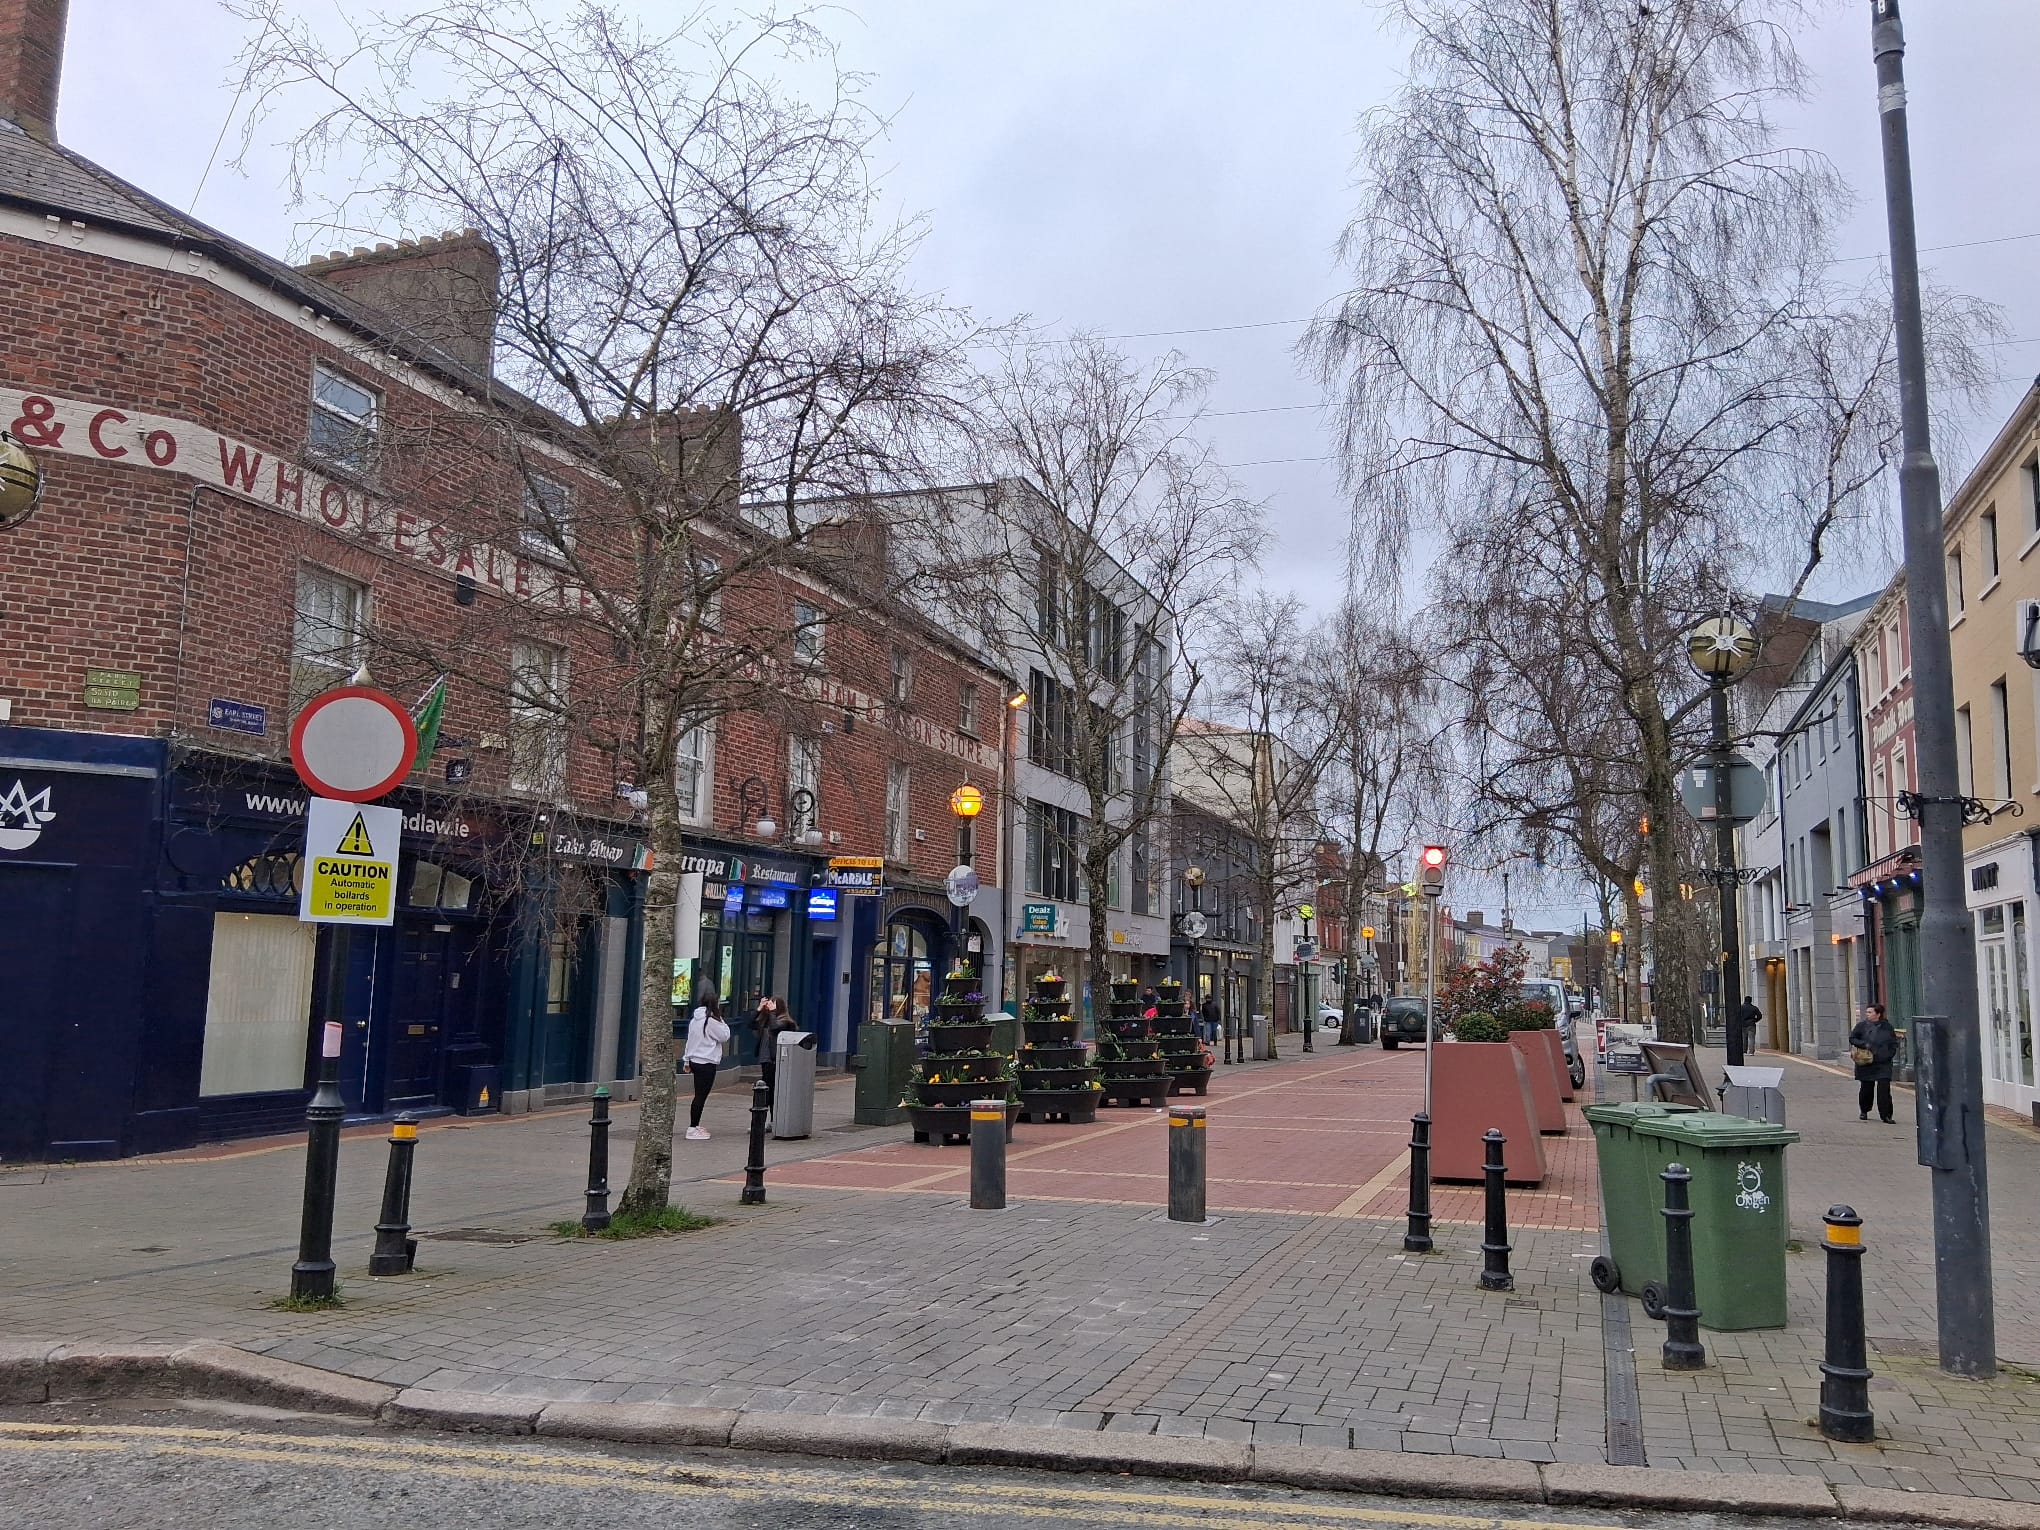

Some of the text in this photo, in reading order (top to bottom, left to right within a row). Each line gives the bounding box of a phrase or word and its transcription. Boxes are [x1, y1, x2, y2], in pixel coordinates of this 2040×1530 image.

[11, 395, 66, 449] &
[88, 408, 177, 467] Co
[555, 834, 624, 862] Take Away
[318, 861, 389, 880] CAUTION
[330, 878, 376, 890] Automatic
[334, 889, 370, 901] bollards
[324, 901, 377, 912] in operation
[1028, 905, 1051, 914] Dealz
